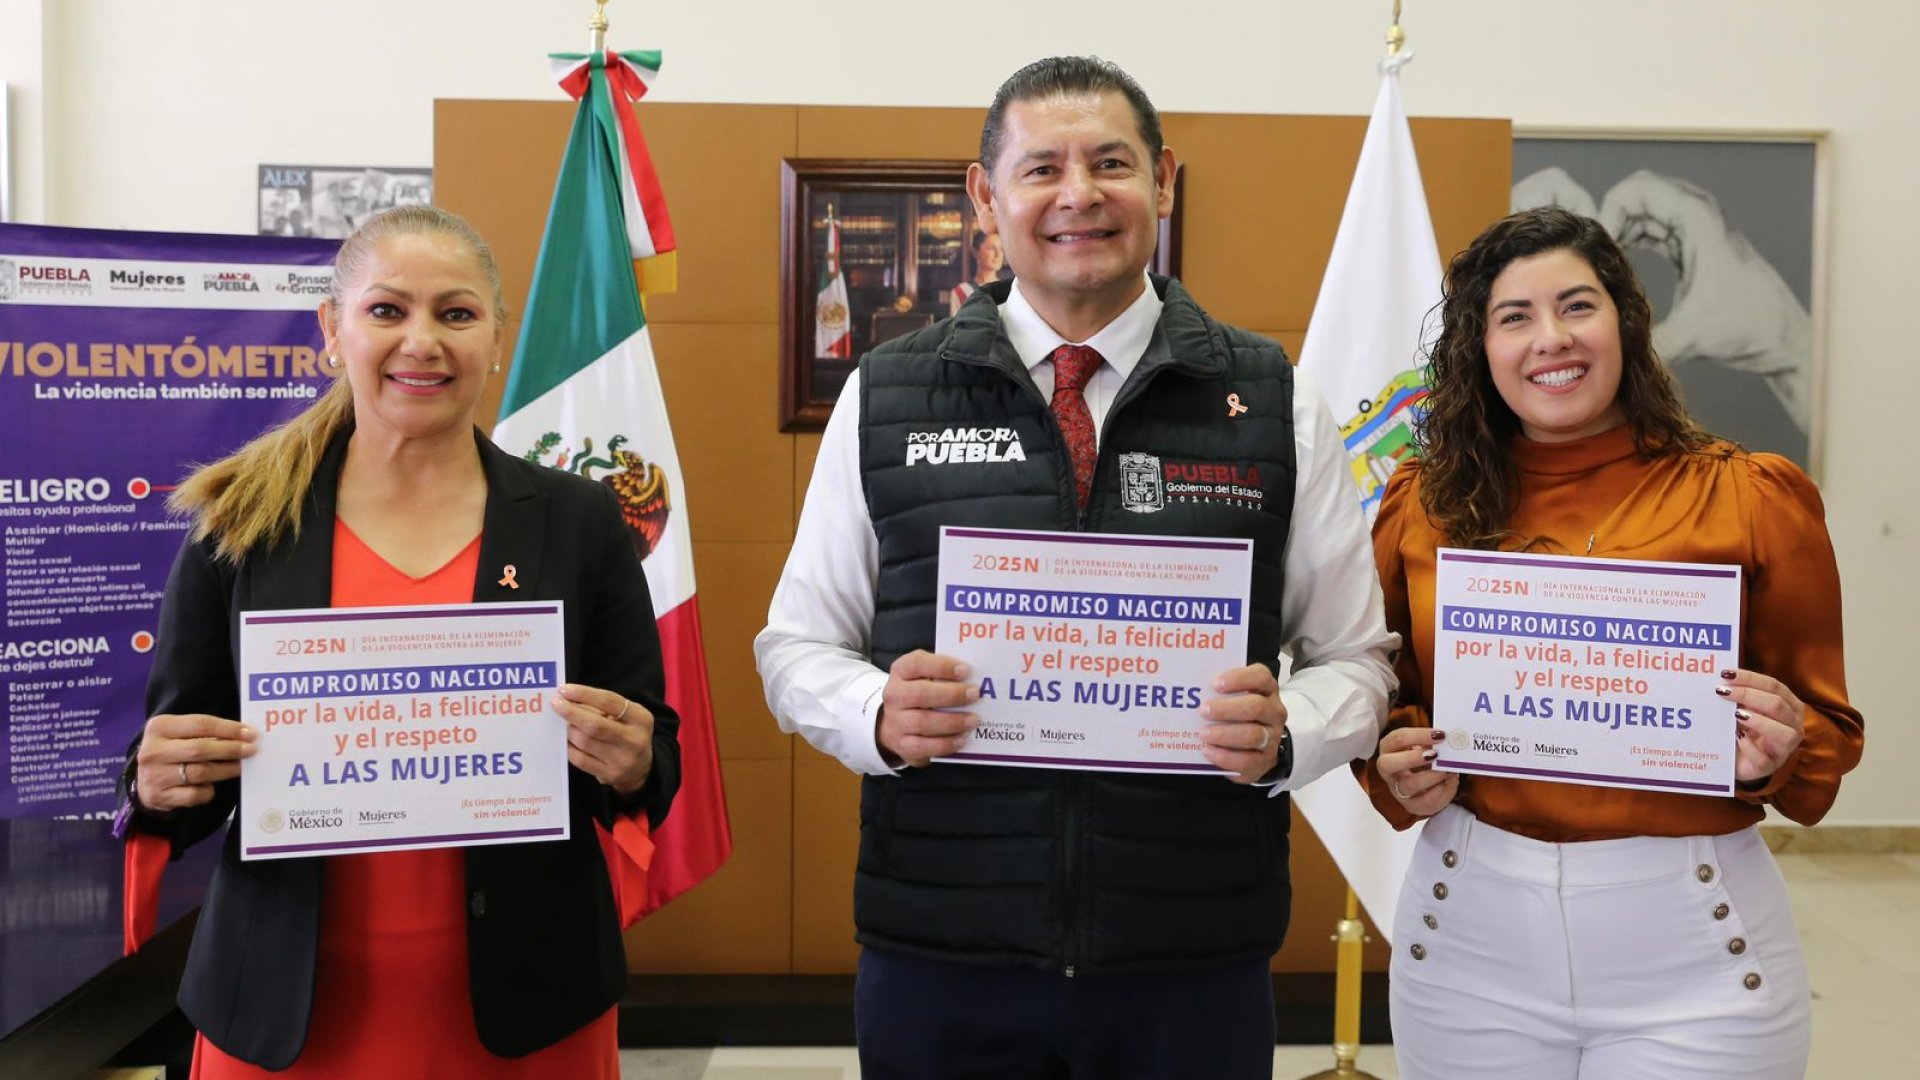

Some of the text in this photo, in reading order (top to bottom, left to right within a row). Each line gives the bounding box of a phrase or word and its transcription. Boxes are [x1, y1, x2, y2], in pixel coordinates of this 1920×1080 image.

[19, 266, 90, 281] PUEBLA
[110, 270, 184, 287] Mujeres
[203, 280, 259, 292] PUEBLA
[35, 382, 317, 399] La violencia también se mide
[905, 440, 1027, 467] PUEBLA
[1163, 463, 1264, 486] PUEBLA
[1166, 481, 1262, 498] Gobierno del Estado
[33, 504, 71, 517] ayuda
[72, 502, 136, 516] profesional
[5, 524, 61, 535] Asesinar
[64, 522, 129, 535] (Homicidio
[5, 536, 45, 545] Mutilar
[39, 556, 71, 564] sexual
[972, 554, 1039, 573] 2025N
[6, 568, 37, 576] Forzar
[67, 565, 108, 573] relación
[109, 562, 140, 571] sexual
[6, 577, 55, 586] Amenazar
[71, 574, 106, 582] muerte
[1467, 577, 1528, 595] 2025N
[6, 587, 46, 596] Difundir
[48, 585, 97, 594] contenido
[7, 608, 56, 616] Amenazar
[58, 606, 76, 614] con
[78, 604, 114, 613] objetos
[124, 602, 154, 610] armas
[953, 589, 1232, 620] COMPROMISO NACIONAL
[7, 617, 61, 626] Sextorción
[1450, 610, 1722, 646] COMPROMISO NACIONAL
[959, 619, 1225, 649] por la vida, la felicidad
[276, 637, 346, 655] 2025N
[1021, 650, 1158, 678] y el respeto
[1456, 639, 1714, 674] por la vida, la felicidad
[12, 660, 46, 673] dejes
[47, 657, 94, 669] destruir
[9, 676, 112, 692] Encerrar o aislar
[257, 666, 548, 696] COMPROMISO NACIONAL
[1515, 668, 1648, 696] y el respeto
[9, 692, 44, 702] Patear
[978, 677, 1201, 712] A LAS MUJERES
[9, 702, 60, 712] Cachetear
[265, 692, 542, 732] por la vida, la felicidad
[1473, 691, 1692, 729] A LAS MUJERES
[9, 712, 50, 723] Empujar
[60, 709, 100, 720] jalonear
[9, 723, 52, 732] Pellizcar
[62, 719, 94, 728] arañar
[9, 733, 48, 743] Golpear
[334, 725, 477, 756] y el respeto
[974, 726, 1024, 741] México
[1040, 728, 1085, 740] Mujeres
[1472, 733, 1509, 743] Gobierno
[10, 738, 99, 753] Caricias agresivas
[1473, 739, 1520, 754] México
[1534, 743, 1578, 755] Mujeres
[1642, 746, 1672, 758] tiempo
[1673, 749, 1684, 757] de
[1685, 751, 1719, 760] mujeres
[10, 752, 59, 762] Manosear
[1641, 758, 1656, 766] sin
[288, 751, 522, 786] A LAS MUJERES
[474, 798, 504, 807] tiempo
[505, 796, 516, 805] de
[518, 795, 552, 806] mujeres
[288, 806, 342, 818] Gobierno de
[359, 810, 406, 821] Mujeres
[473, 810, 489, 819] sin
[289, 814, 342, 829] México
